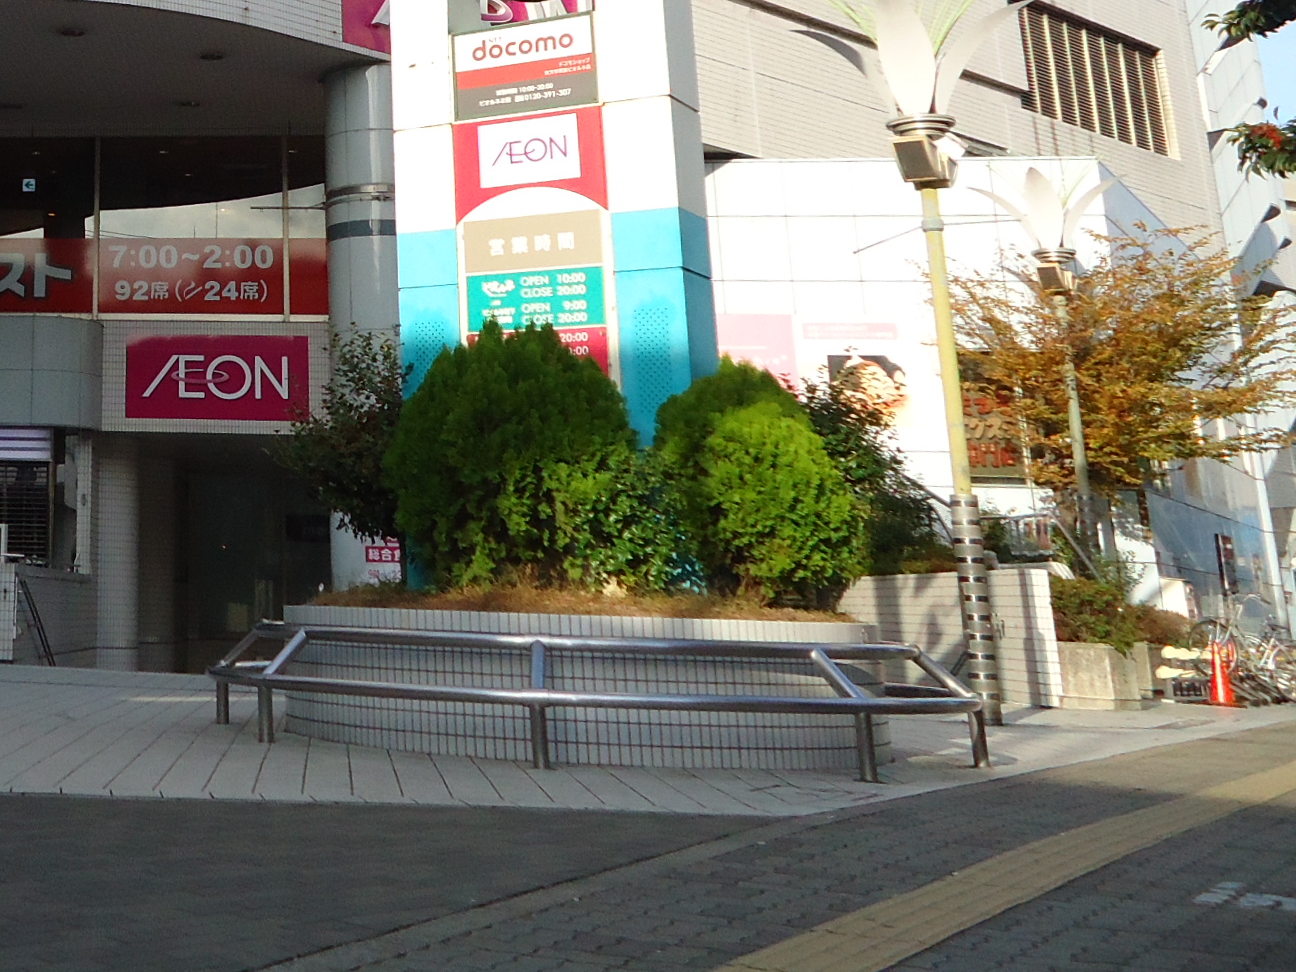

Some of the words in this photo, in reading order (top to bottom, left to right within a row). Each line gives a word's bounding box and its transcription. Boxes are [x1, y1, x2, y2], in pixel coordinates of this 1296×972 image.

[472, 33, 574, 61] docomo
[488, 231, 575, 257] 営業時間
[520, 275, 550, 286] OPEN
[557, 272, 587, 283] 10:00
[520, 286, 553, 298] CLOSE
[557, 284, 587, 296] 20:00
[521, 302, 551, 313] OPEN
[563, 300, 588, 311] 9:00
[558, 312, 588, 323] 20:00
